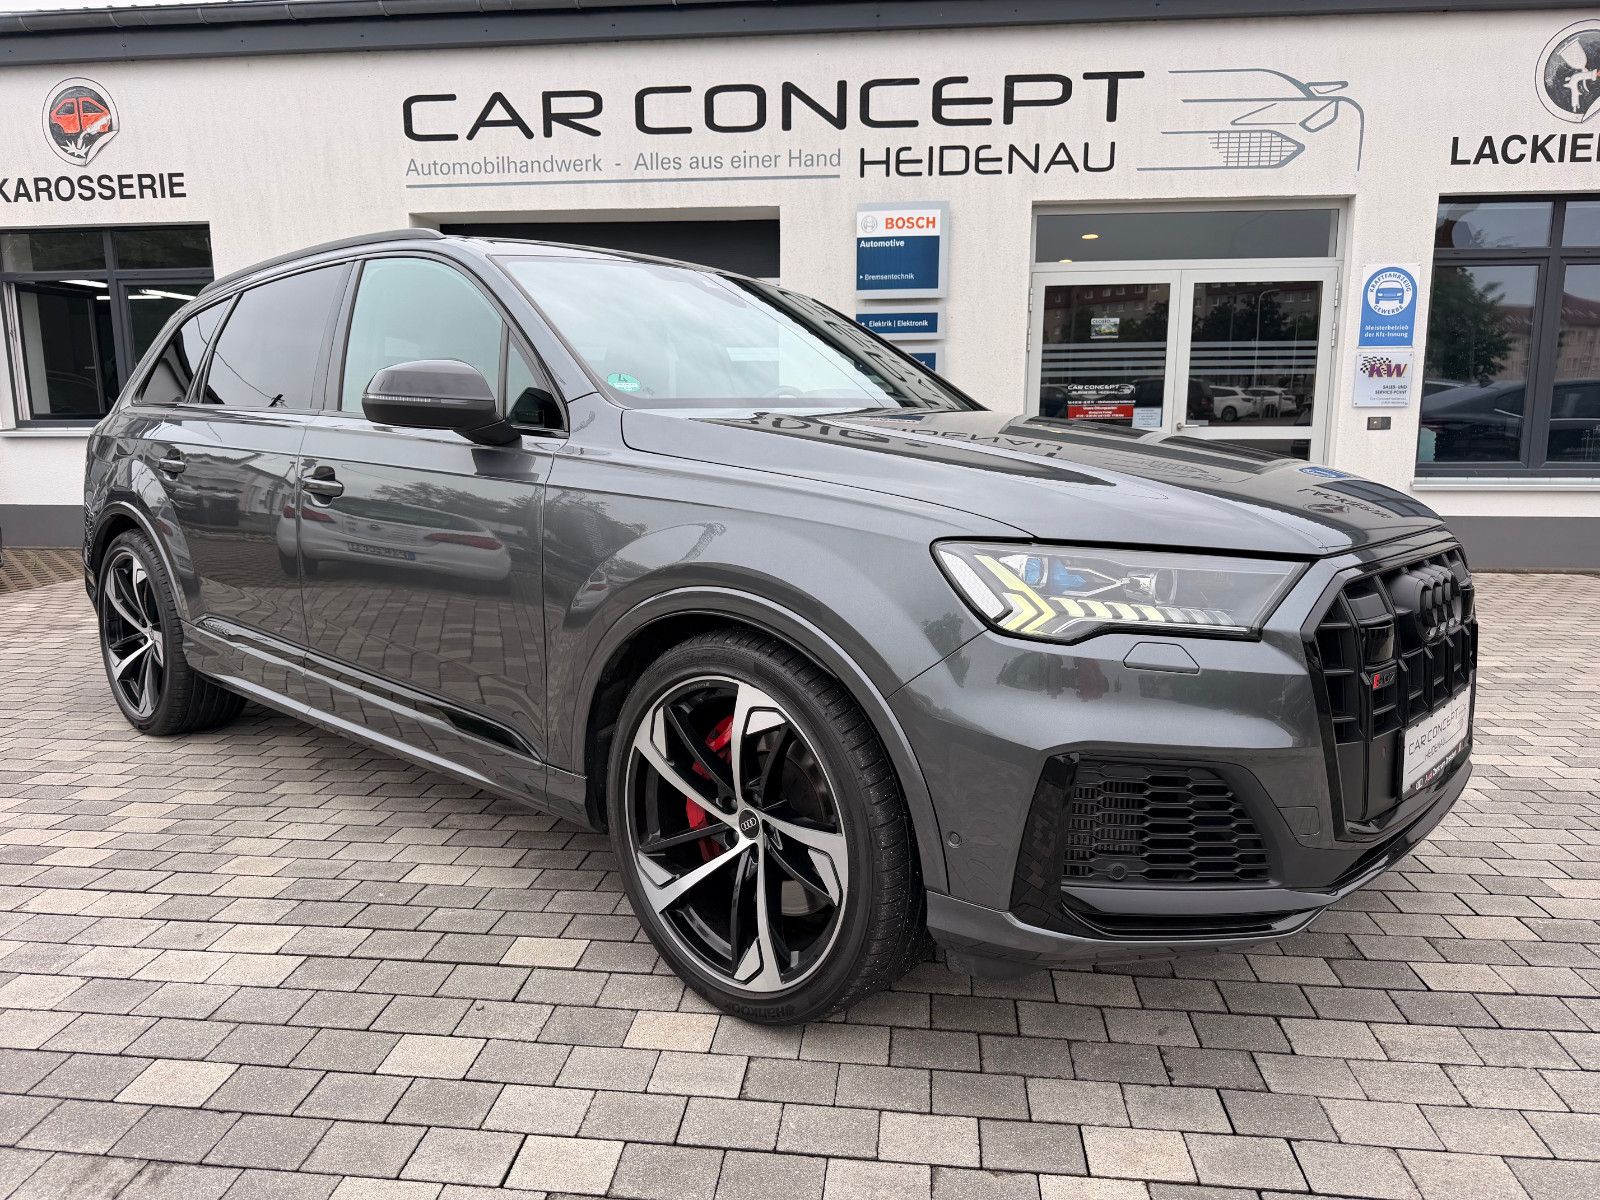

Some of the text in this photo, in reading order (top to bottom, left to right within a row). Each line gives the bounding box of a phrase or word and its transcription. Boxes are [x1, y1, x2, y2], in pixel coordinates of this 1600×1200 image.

[403, 71, 1144, 141] CAR CONCEPT
[1450, 133, 1600, 165] LACKIE
[406, 154, 602, 176] Automobilhandwerk
[634, 153, 681, 170] Alles
[690, 157, 723, 169] aus
[731, 155, 780, 169] einer
[789, 149, 840, 168] Hand
[860, 142, 1115, 178] HEIDENAU
[0, 173, 187, 202] KAROSSERIE
[885, 217, 936, 229] BOSCH
[860, 239, 905, 248] Automotive
[864, 272, 915, 280] Bremsentechnik
[1370, 272, 1411, 292] KRAFTFAHRZEUG
[1374, 305, 1403, 314] GEWERBE
[1368, 363, 1407, 378] KW
[1408, 734, 1426, 756] CAR
